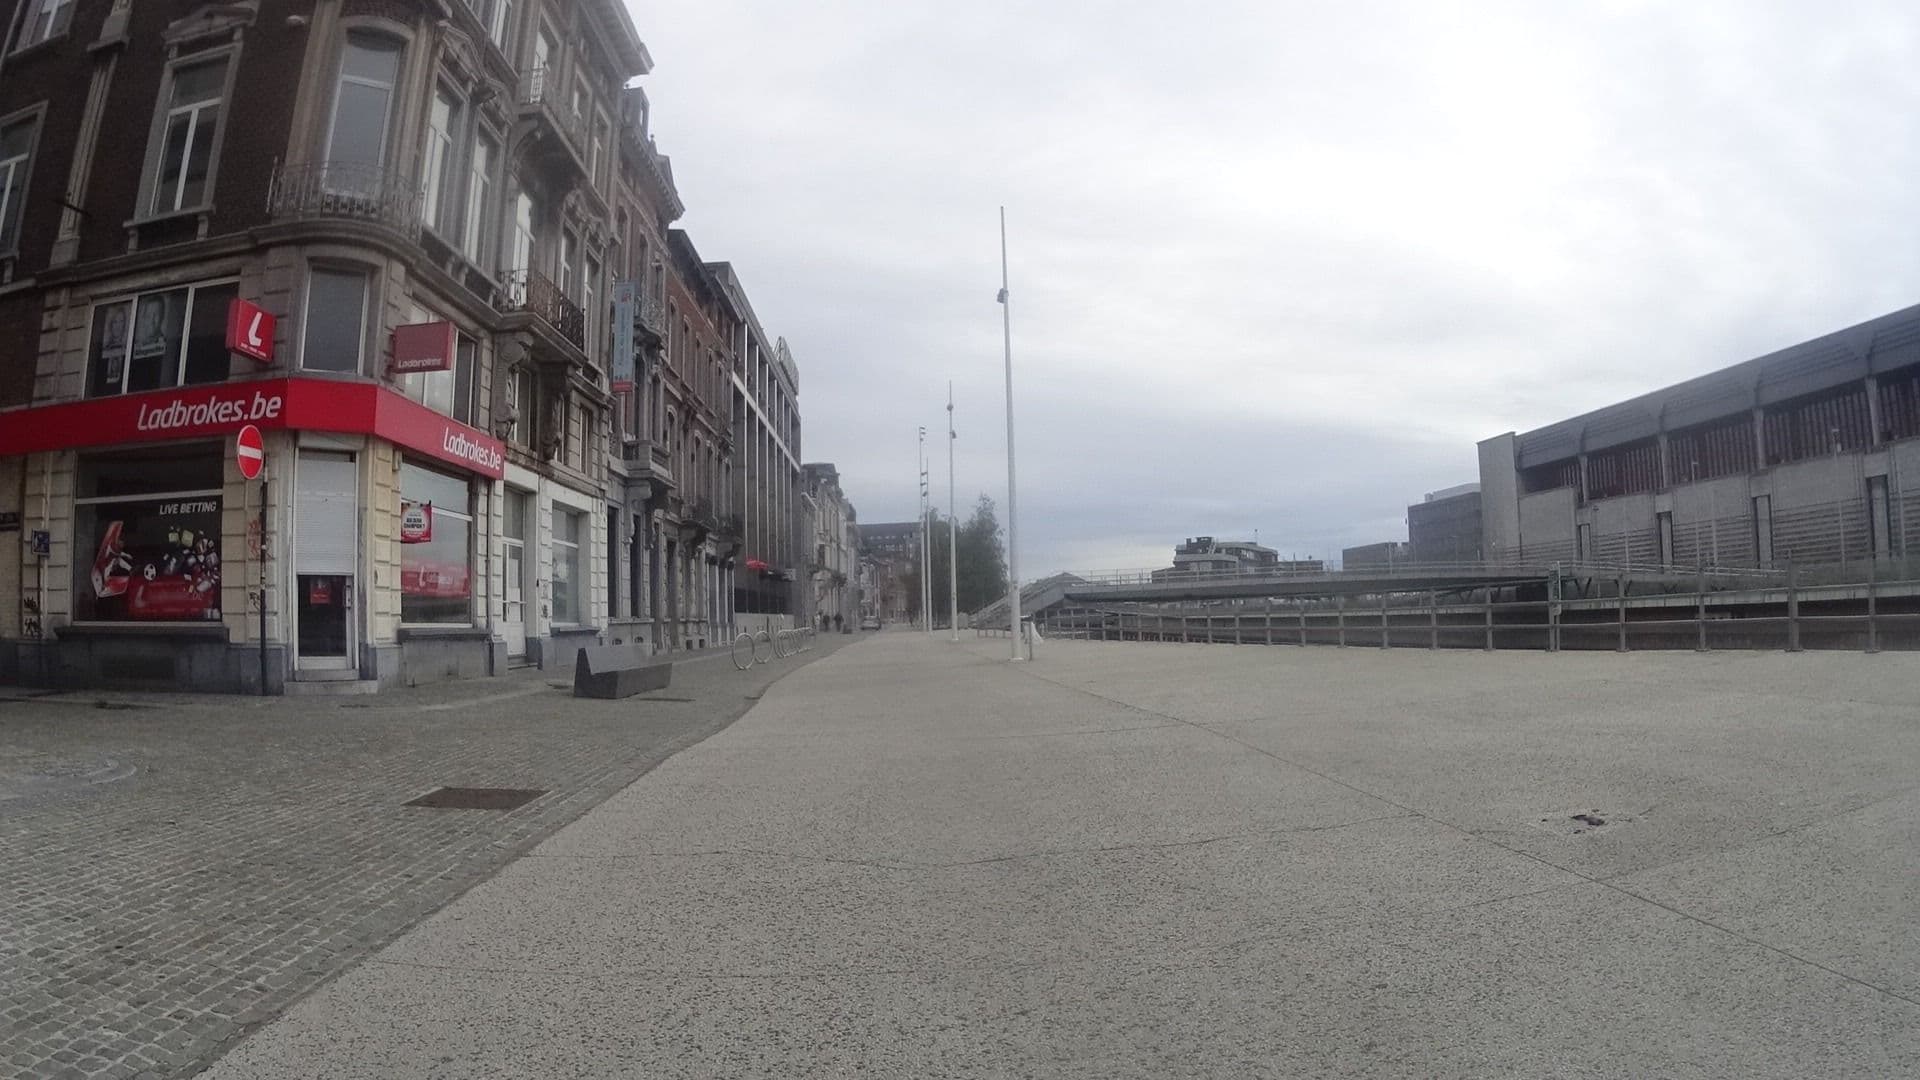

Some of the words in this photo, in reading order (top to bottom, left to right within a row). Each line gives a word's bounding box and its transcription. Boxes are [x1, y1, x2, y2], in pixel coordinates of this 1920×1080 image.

[138, 392, 281, 430] Ladbrokes.be
[443, 428, 501, 470] Ladbrokes.be
[160, 503, 178, 515] LIVE
[180, 502, 216, 514] BETTING
